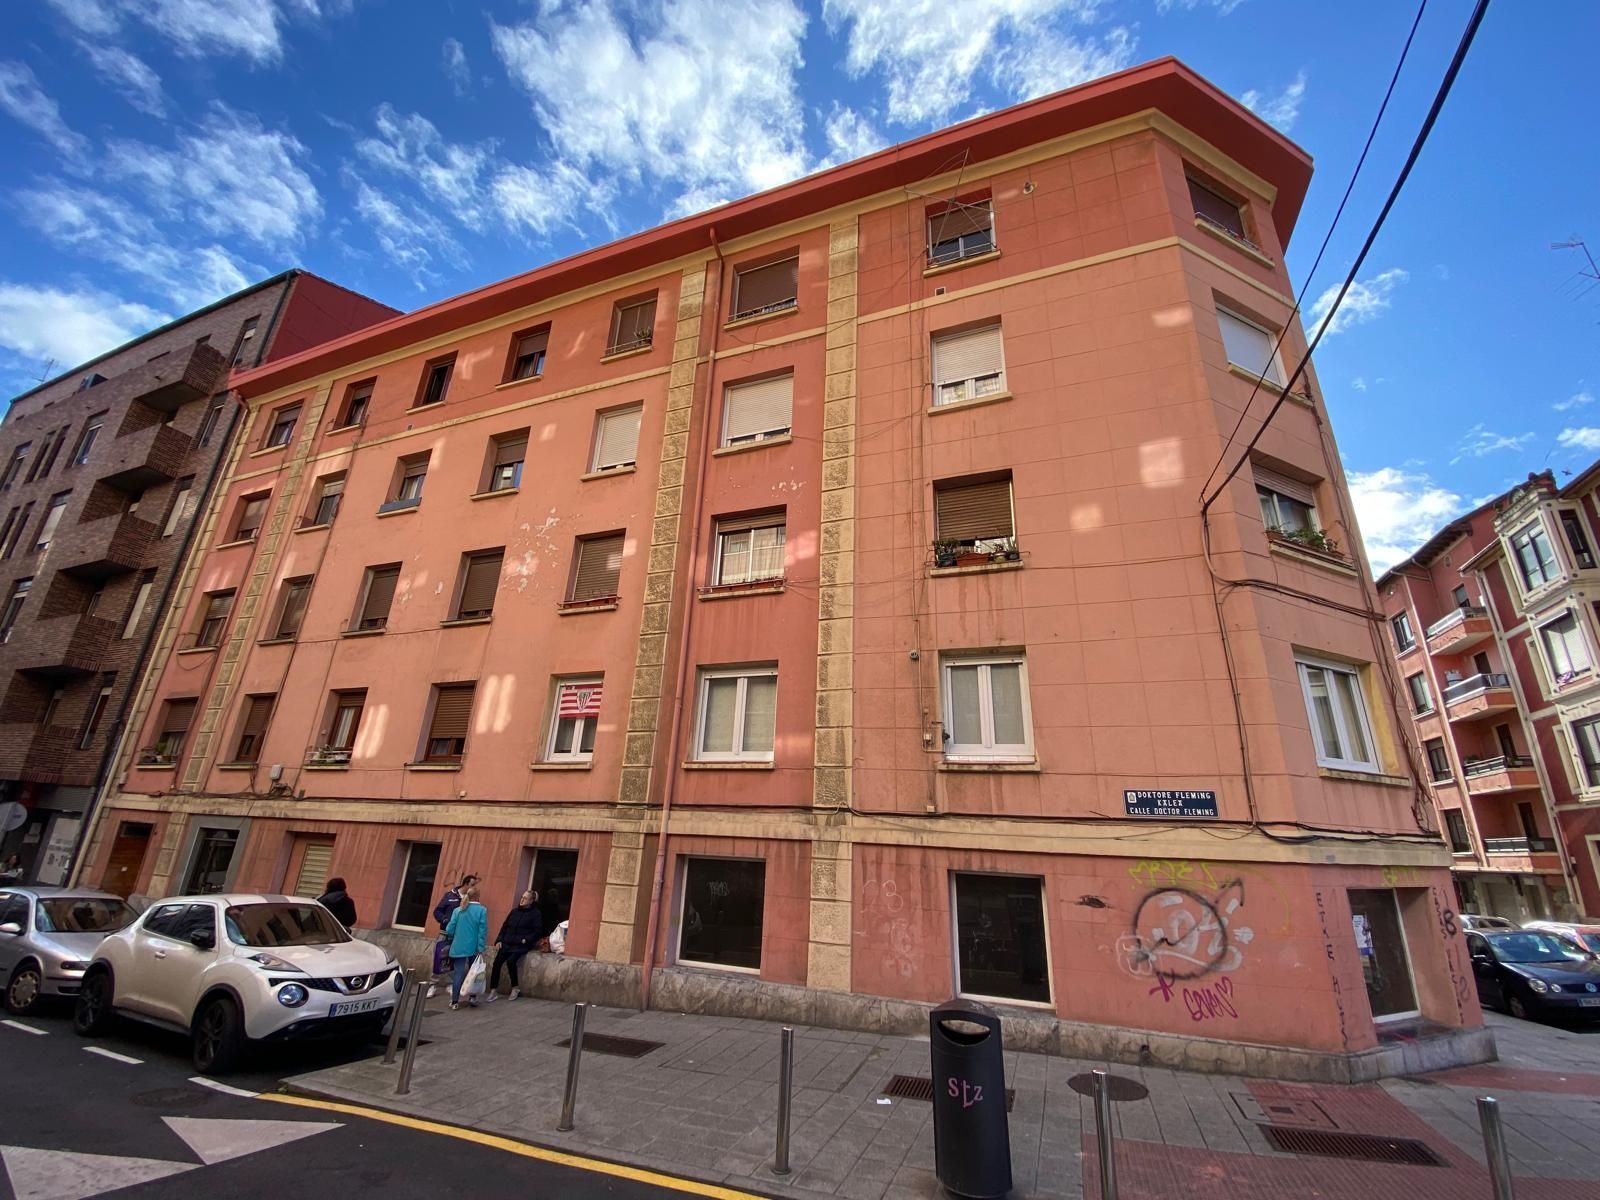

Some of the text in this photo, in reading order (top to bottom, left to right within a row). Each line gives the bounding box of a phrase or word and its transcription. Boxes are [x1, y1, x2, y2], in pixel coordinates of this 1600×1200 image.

[1137, 791, 1211, 799] DOKTORE FLEMING
[1129, 807, 1214, 816] CALLE DOCTOR FLEMING
[337, 1000, 378, 1015] 7915 KKT
